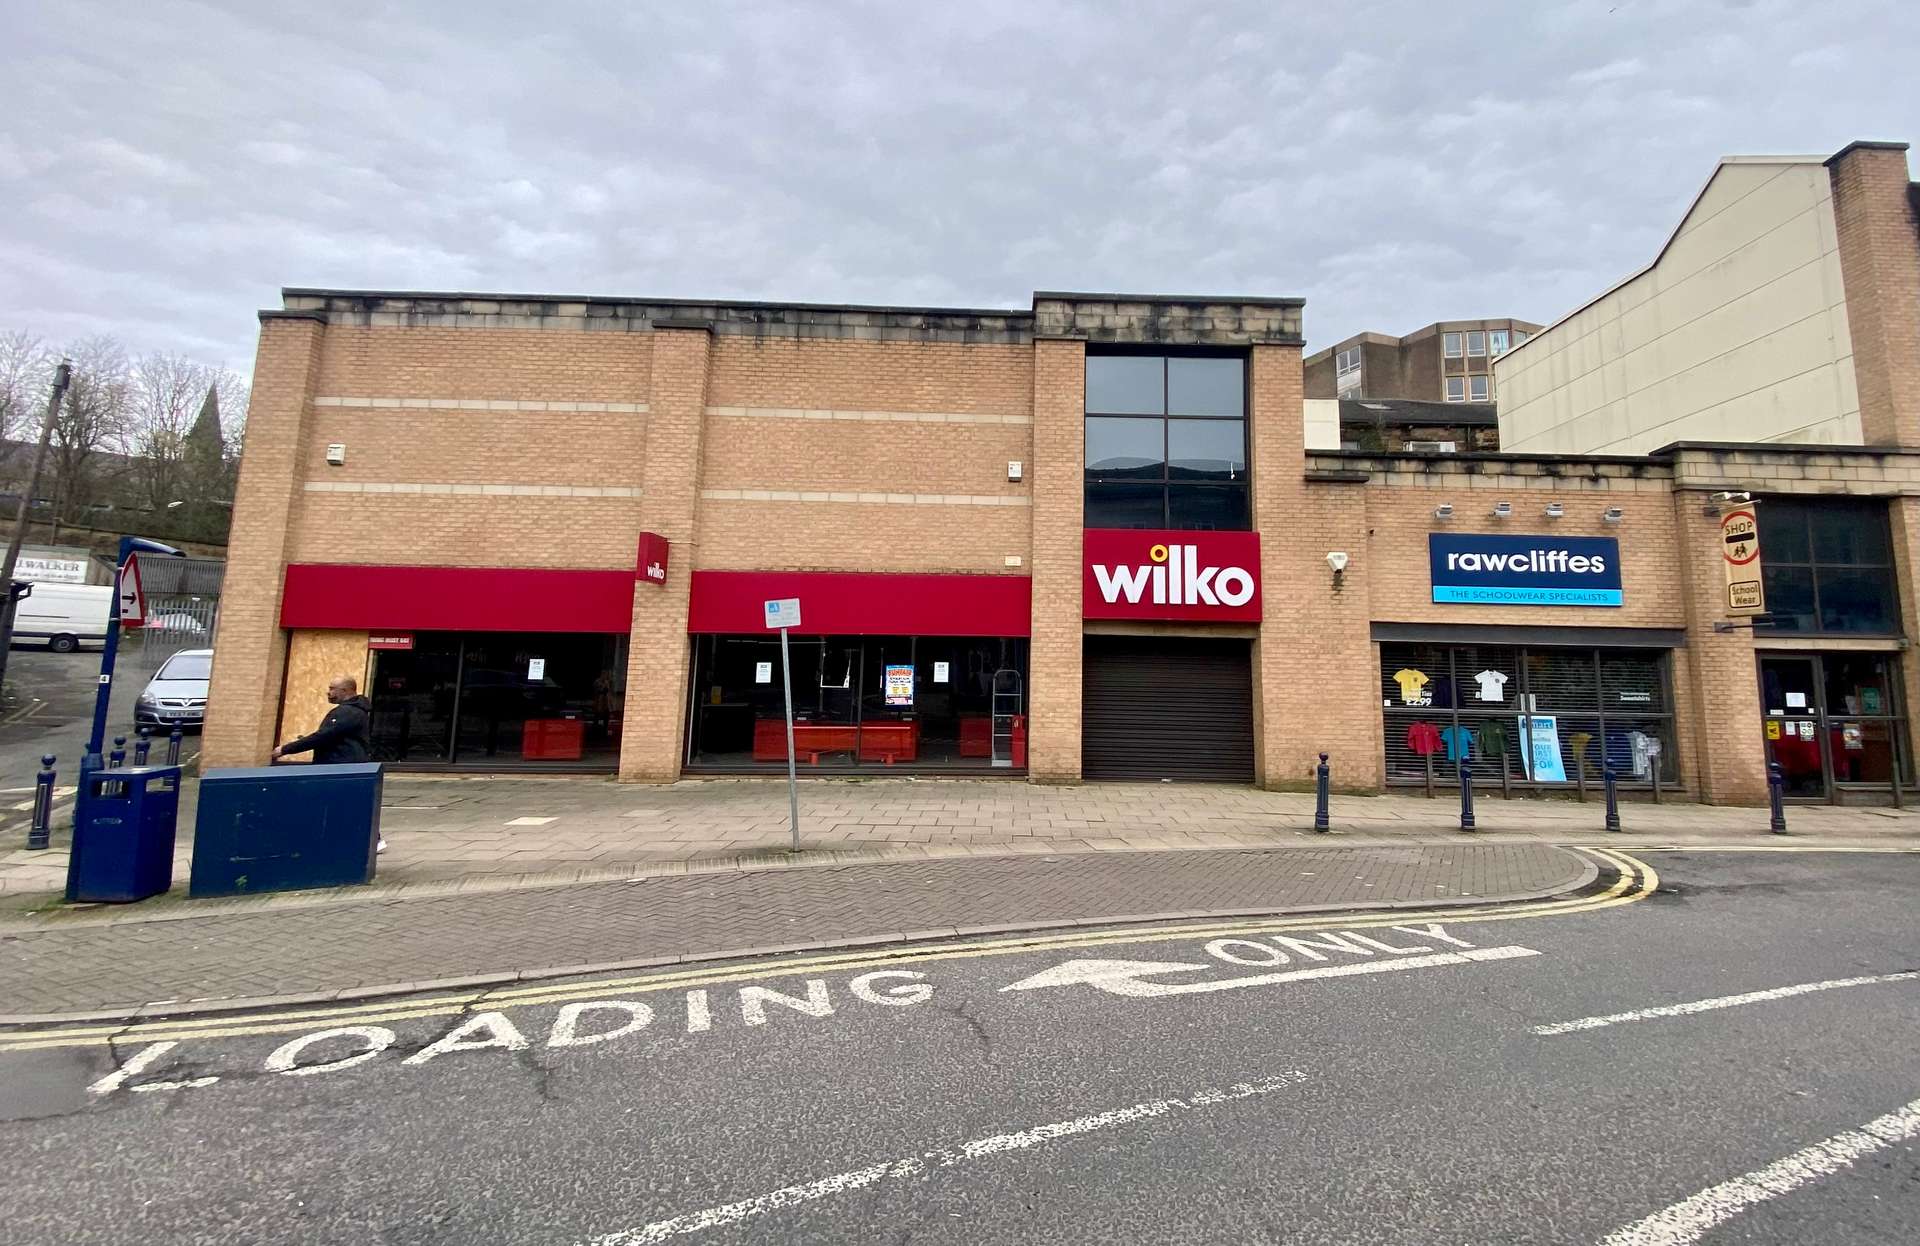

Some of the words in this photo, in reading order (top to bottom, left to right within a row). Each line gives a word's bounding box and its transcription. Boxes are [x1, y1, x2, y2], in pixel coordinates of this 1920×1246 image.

[1725, 521, 1753, 534] SHOP
[1447, 550, 1606, 574] rawcliffes
[1092, 544, 1255, 607] wilko
[1450, 590, 1470, 599] THE
[1472, 591, 1546, 600] SCHOOLWEAR
[1548, 592, 1609, 601] SPECIALISTS
[1731, 585, 1758, 595] School
[1734, 595, 1756, 605] Wear
[1203, 923, 1476, 967] ONLY
[86, 969, 937, 1097] LOADING
